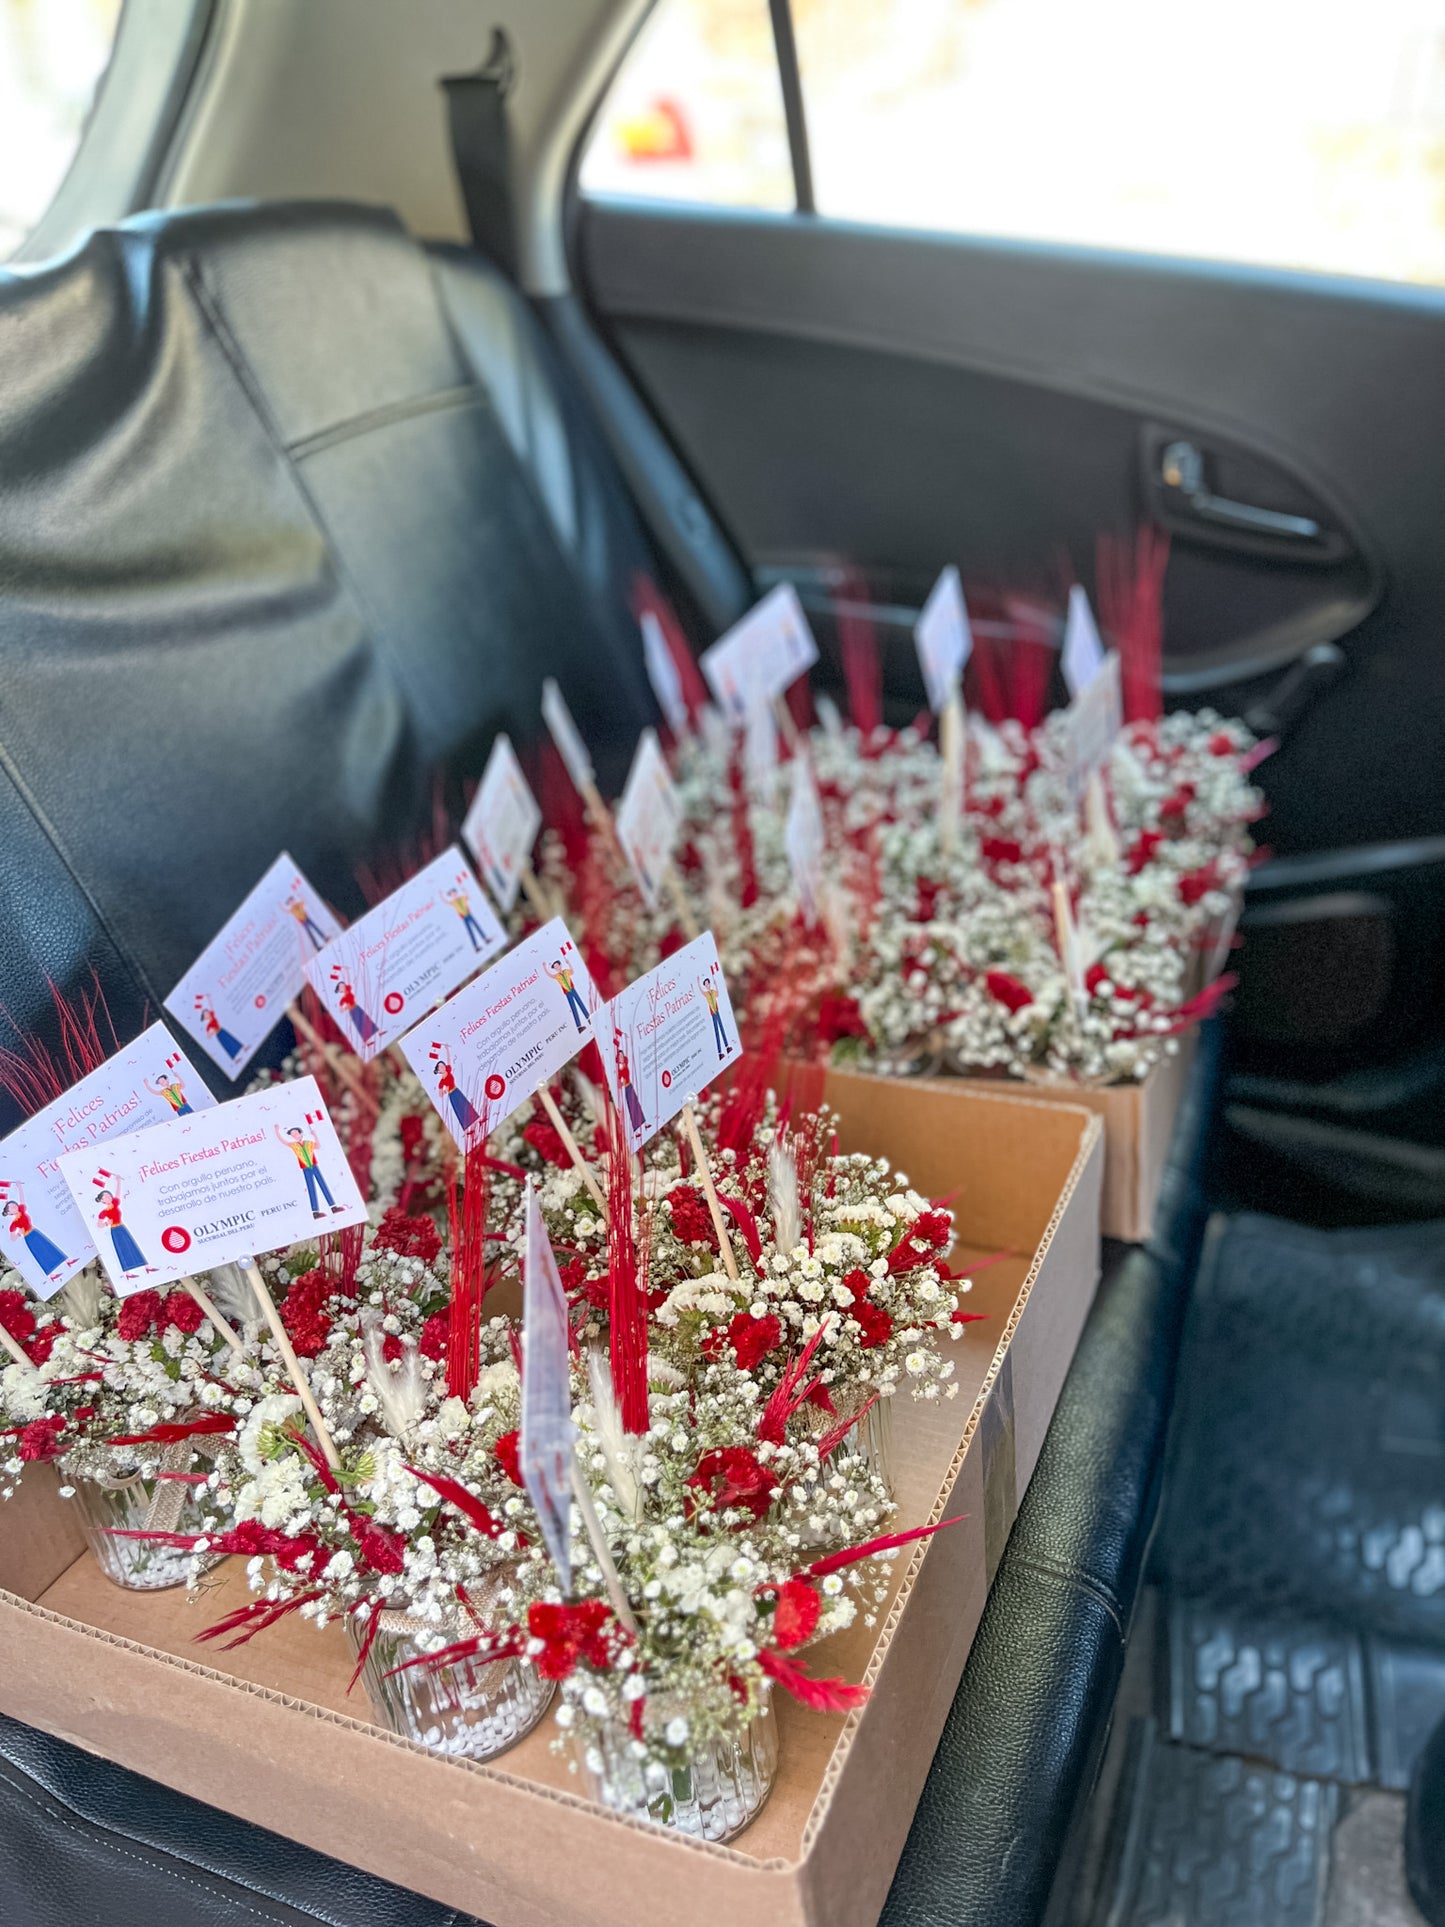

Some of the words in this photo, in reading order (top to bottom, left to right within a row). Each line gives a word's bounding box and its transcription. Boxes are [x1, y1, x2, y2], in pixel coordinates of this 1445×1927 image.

[403, 961, 440, 996] OLYMPIC
[485, 994, 512, 1018] Fiestas
[510, 968, 540, 997] Patrias!
[476, 1036, 491, 1050] Con
[505, 1041, 544, 1079] OLYMPIC
[545, 1029, 559, 1044] PERU
[558, 1022, 568, 1033] INC
[50, 1095, 105, 1144] ¡Felices
[85, 1090, 142, 1140] Patrias!
[138, 1160, 180, 1182] ¡Felices
[180, 1146, 221, 1166] Fiestas
[220, 1128, 267, 1154] Patrias!
[158, 1184, 211, 1206] trabajamos
[211, 1174, 239, 1193] juntos
[240, 1169, 257, 1183] por
[258, 1166, 267, 1176] el
[158, 1197, 203, 1218] desarrollo
[204, 1192, 217, 1203] de
[218, 1183, 253, 1200] nuestro
[159, 1184, 180, 1195] Con
[181, 1171, 213, 1188] orgullo
[193, 1210, 256, 1238] OLYMPIC
[261, 1205, 282, 1217] PERU
[283, 1199, 298, 1211] INC
